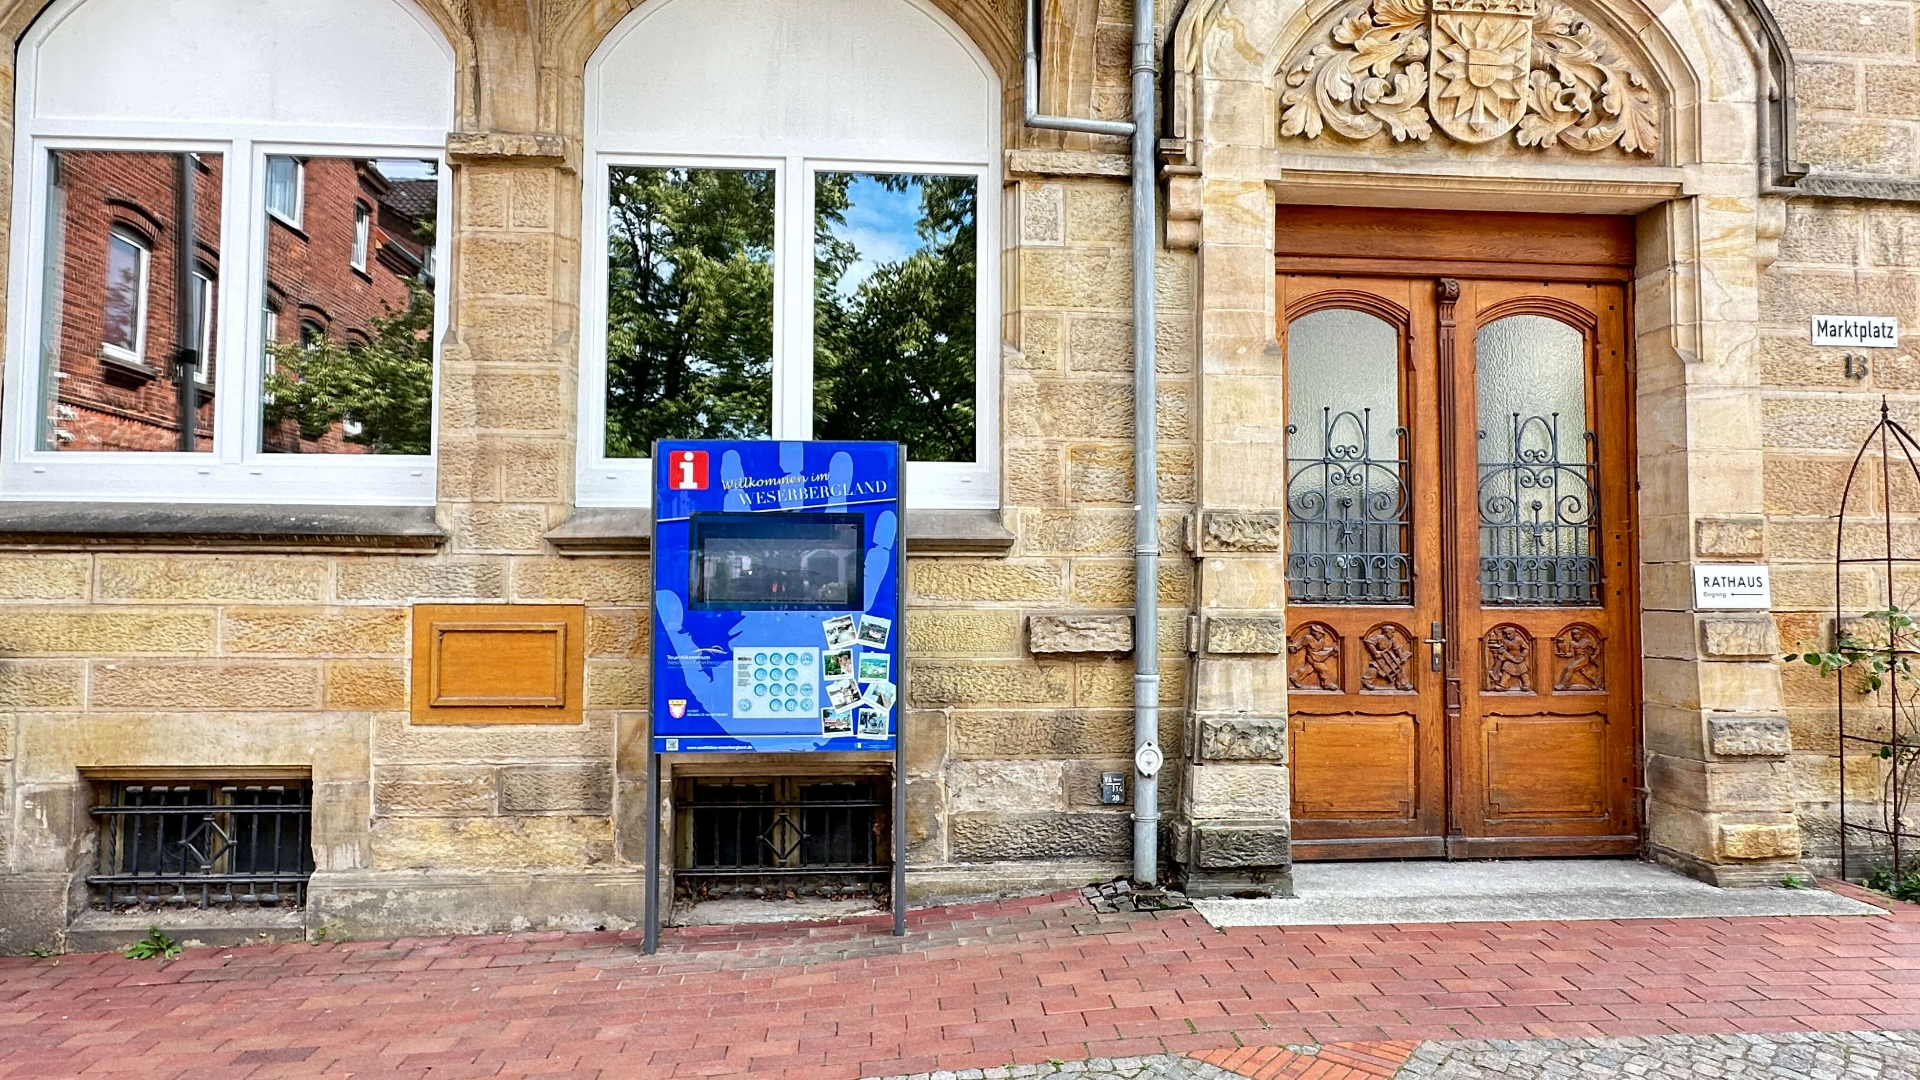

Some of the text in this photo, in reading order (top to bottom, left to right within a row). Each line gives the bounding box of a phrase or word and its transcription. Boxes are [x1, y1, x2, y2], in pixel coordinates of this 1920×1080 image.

[1817, 319, 1894, 342] Marktplatz
[1844, 353, 1869, 380] 13
[722, 471, 831, 490] Willkommen im
[738, 480, 887, 506] WESERBERGLAND
[1703, 576, 1763, 588] RATHAUS
[1703, 591, 1727, 599] Eingang
